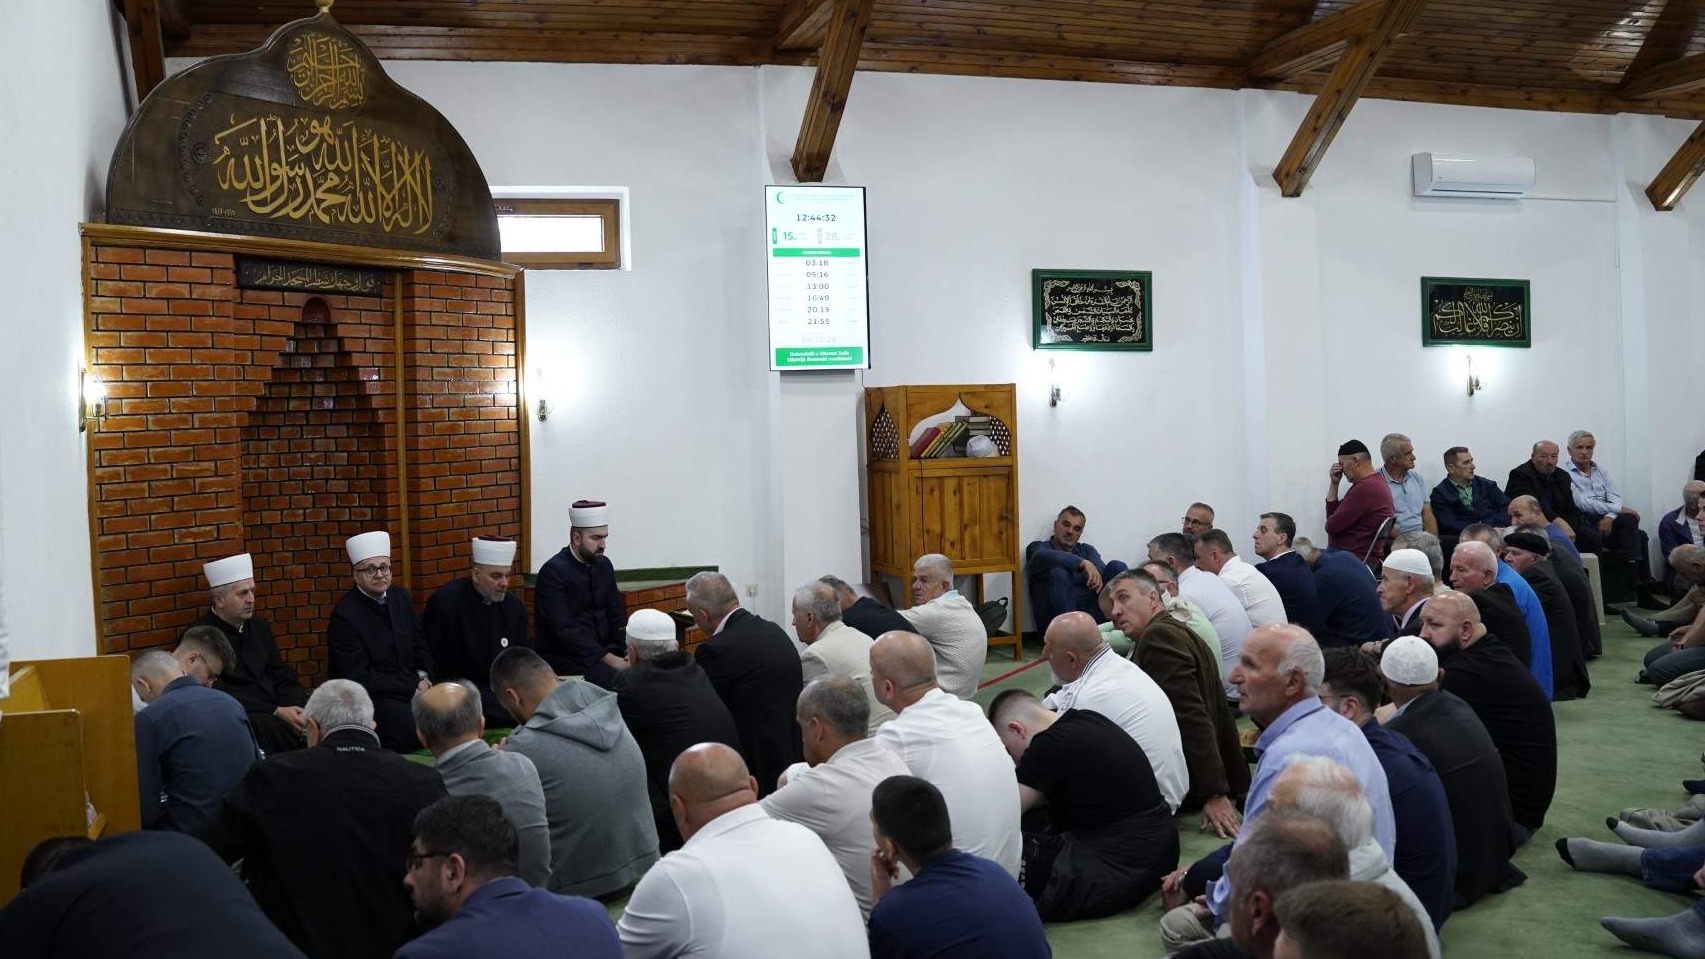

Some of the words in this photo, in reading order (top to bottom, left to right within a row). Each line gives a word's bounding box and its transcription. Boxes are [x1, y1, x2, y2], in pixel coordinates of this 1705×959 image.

[796, 213, 836, 222] 12:44:32
[805, 259, 829, 267] 03:18
[806, 282, 830, 290] 13:00
